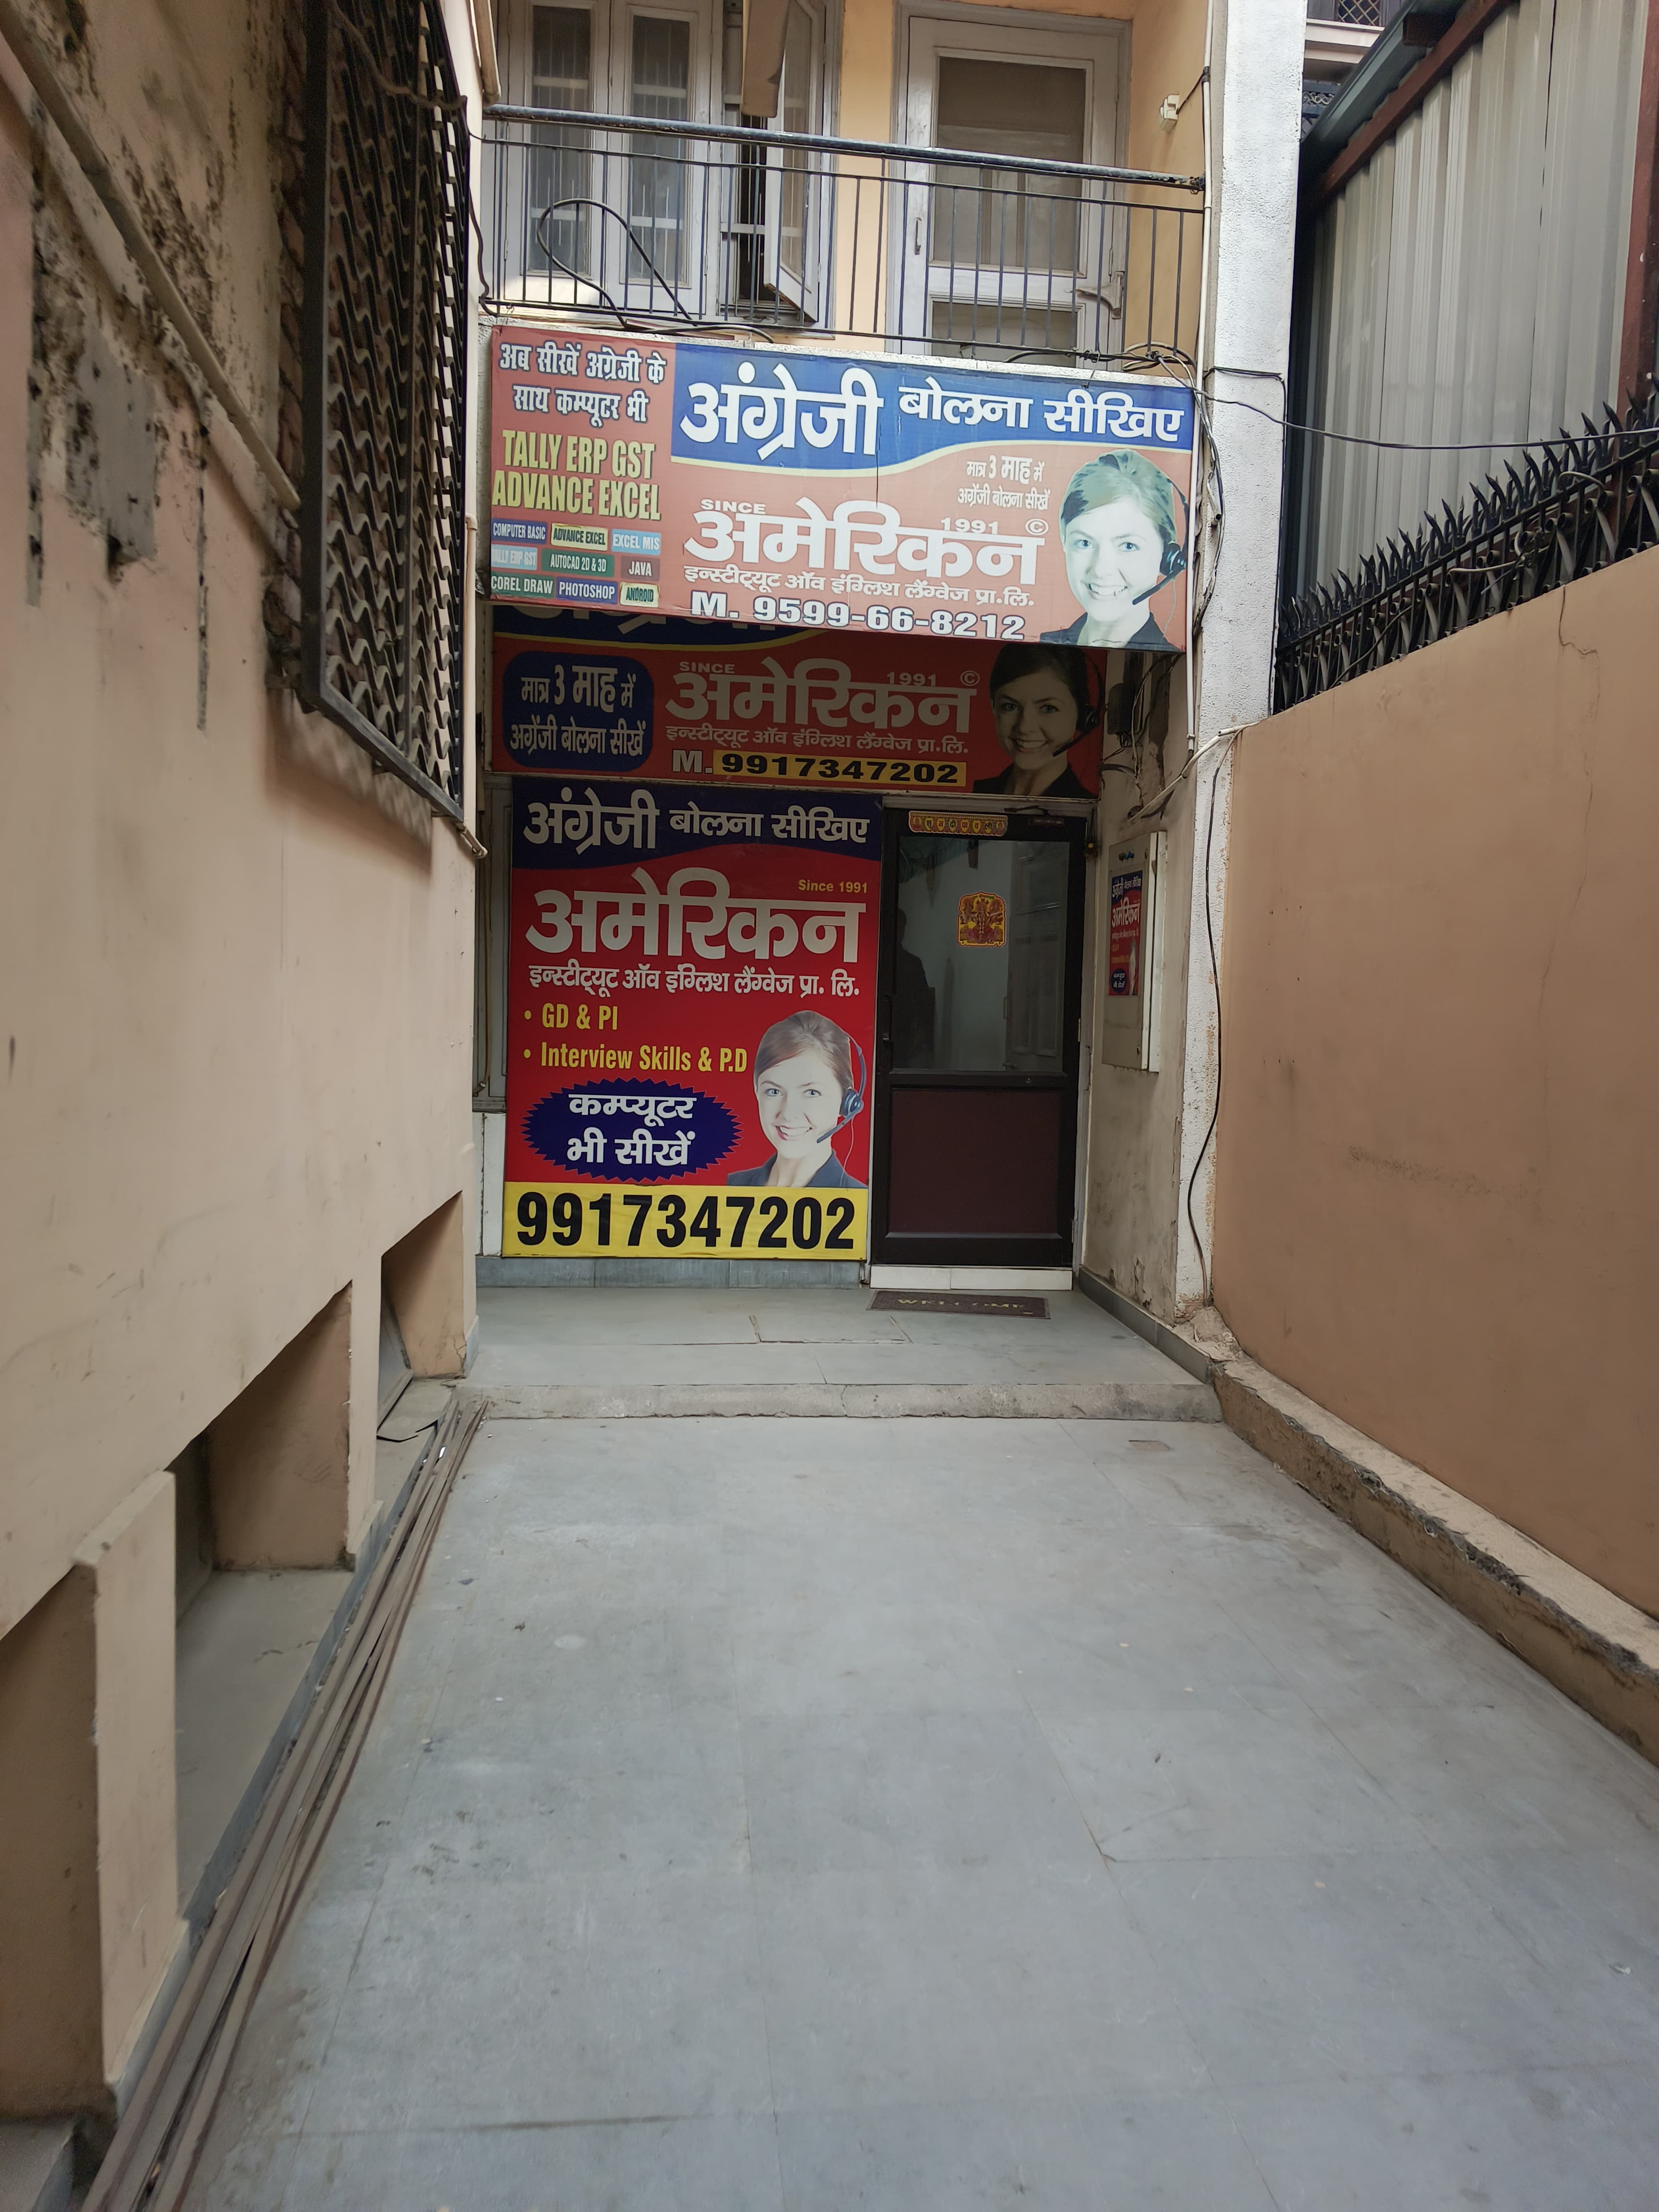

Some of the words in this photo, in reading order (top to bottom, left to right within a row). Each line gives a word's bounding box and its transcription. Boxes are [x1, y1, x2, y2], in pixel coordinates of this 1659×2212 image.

[500, 344, 531, 370] अब
[537, 342, 581, 375] सीखें
[647, 352, 666, 383] के
[555, 390, 621, 427] कम्प्यूटर
[627, 390, 649, 422] भी
[680, 361, 884, 460] अंग्रेजी
[898, 376, 1034, 429] बोलना
[1044, 389, 1185, 441] सीखिए
[503, 430, 562, 470] TALLY
[566, 436, 607, 474] ERP
[612, 440, 655, 479] GST
[966, 461, 986, 477] मात्र
[988, 455, 997, 479] 3
[1001, 456, 1033, 484] माह
[1033, 461, 1045, 482] में
[492, 470, 593, 514] ADVANCE
[599, 480, 661, 520] EXCEL
[992, 485, 1023, 508] बोलना
[1025, 487, 1051, 511] सीखें
[493, 522, 526, 538] COMPUTER
[528, 525, 545, 540] BASIC
[701, 499, 766, 515] SINCE
[940, 517, 998, 534] 1991
[553, 528, 584, 543] ADVANCE
[586, 531, 606, 545] EXCEL
[613, 533, 640, 549] EXCEL
[642, 536, 660, 550] MIS
[684, 496, 1045, 585] अमेरिकन
[510, 550, 523, 565] ERP
[524, 552, 537, 566] GST
[550, 554, 580, 570] AUTOCAD
[581, 557, 590, 571] 2D
[591, 558, 597, 572] &
[598, 559, 606, 572] 3D
[628, 561, 652, 576] JAVA
[491, 576, 521, 592] COREL
[524, 578, 553, 594] DRAW
[559, 581, 615, 600] PHOTOSHOP
[626, 587, 654, 602] ANDROID
[784, 571, 826, 591] ऑव
[830, 574, 901, 596] इंग्लिश
[905, 579, 970, 602] लैंग्वेज
[691, 590, 739, 619] M.
[753, 596, 1025, 640] 9599-66-8212
[521, 677, 550, 703] मात्र
[554, 664, 565, 705] 3
[572, 665, 618, 712] माह
[621, 673, 636, 708] में
[679, 661, 735, 674] SINCE
[887, 672, 937, 687] 1991
[665, 656, 977, 733] अमेरिकन
[561, 716, 606, 754] बोलना
[609, 718, 647, 757] सीखें
[752, 727, 788, 744] ऑव
[792, 728, 852, 748] इंग्लिश
[856, 731, 913, 751] लैंग्वेज
[672, 749, 713, 774] M.
[722, 753, 958, 783] 9917347202
[523, 787, 660, 855] अंग्रेजी
[669, 801, 764, 837] बोलना
[771, 805, 870, 843] सीखिए
[798, 879, 834, 892] Since
[839, 881, 868, 893] 1991
[525, 866, 866, 962] अमेरिकन
[622, 963, 661, 989] ऑव
[734, 965, 795, 994] लैंग्वेज
[799, 976, 824, 998] प्रा.
[830, 968, 859, 997] लि.
[542, 1003, 569, 1028] GD
[576, 1004, 591, 1029] &
[599, 1005, 618, 1030] PI
[541, 1042, 633, 1069] Interview
[639, 1045, 691, 1071] Skills
[698, 1046, 712, 1072] &
[720, 1048, 747, 1072] P.D
[568, 1094, 697, 1127] कम्प्यूटर
[567, 1127, 607, 1163] भी
[614, 1128, 696, 1166] सीखें
[517, 1191, 855, 1250] 9917347202
